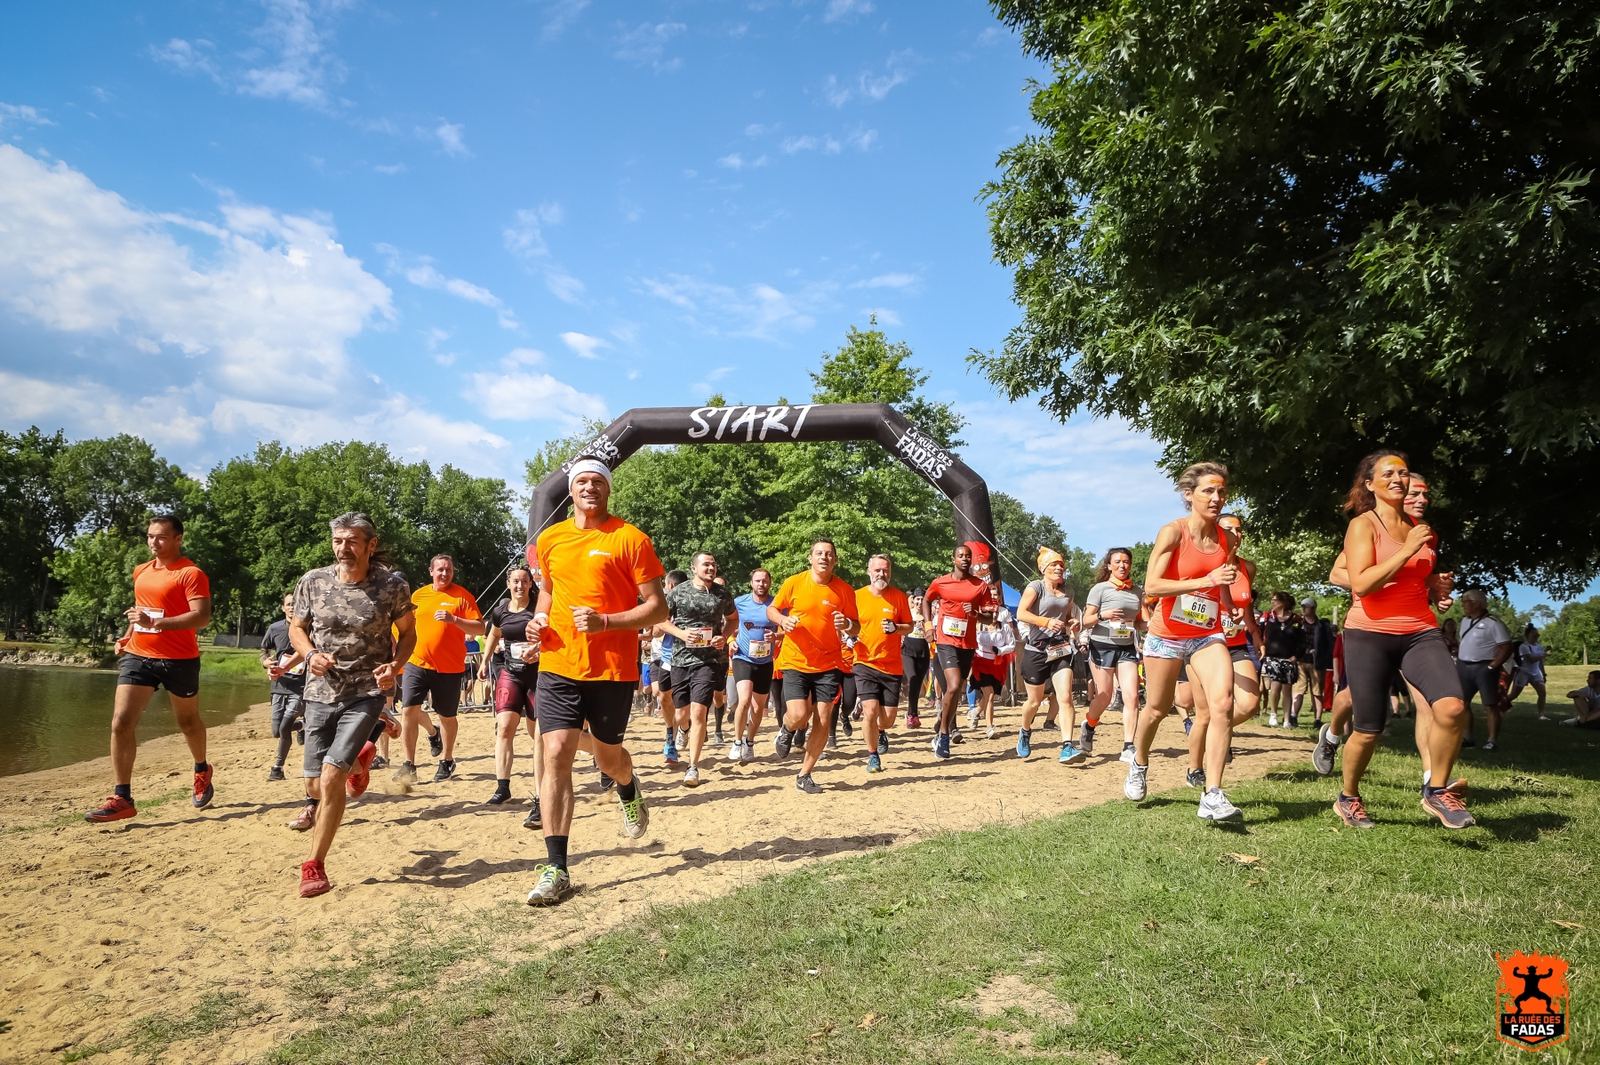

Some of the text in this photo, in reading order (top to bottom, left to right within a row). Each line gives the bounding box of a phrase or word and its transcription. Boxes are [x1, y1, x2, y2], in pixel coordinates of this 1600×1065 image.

[593, 433, 609, 449] DES
[688, 404, 824, 442] START
[895, 434, 947, 479] FADAS
[905, 427, 918, 440] LA
[936, 451, 954, 467] DES
[1191, 601, 1207, 613] 616
